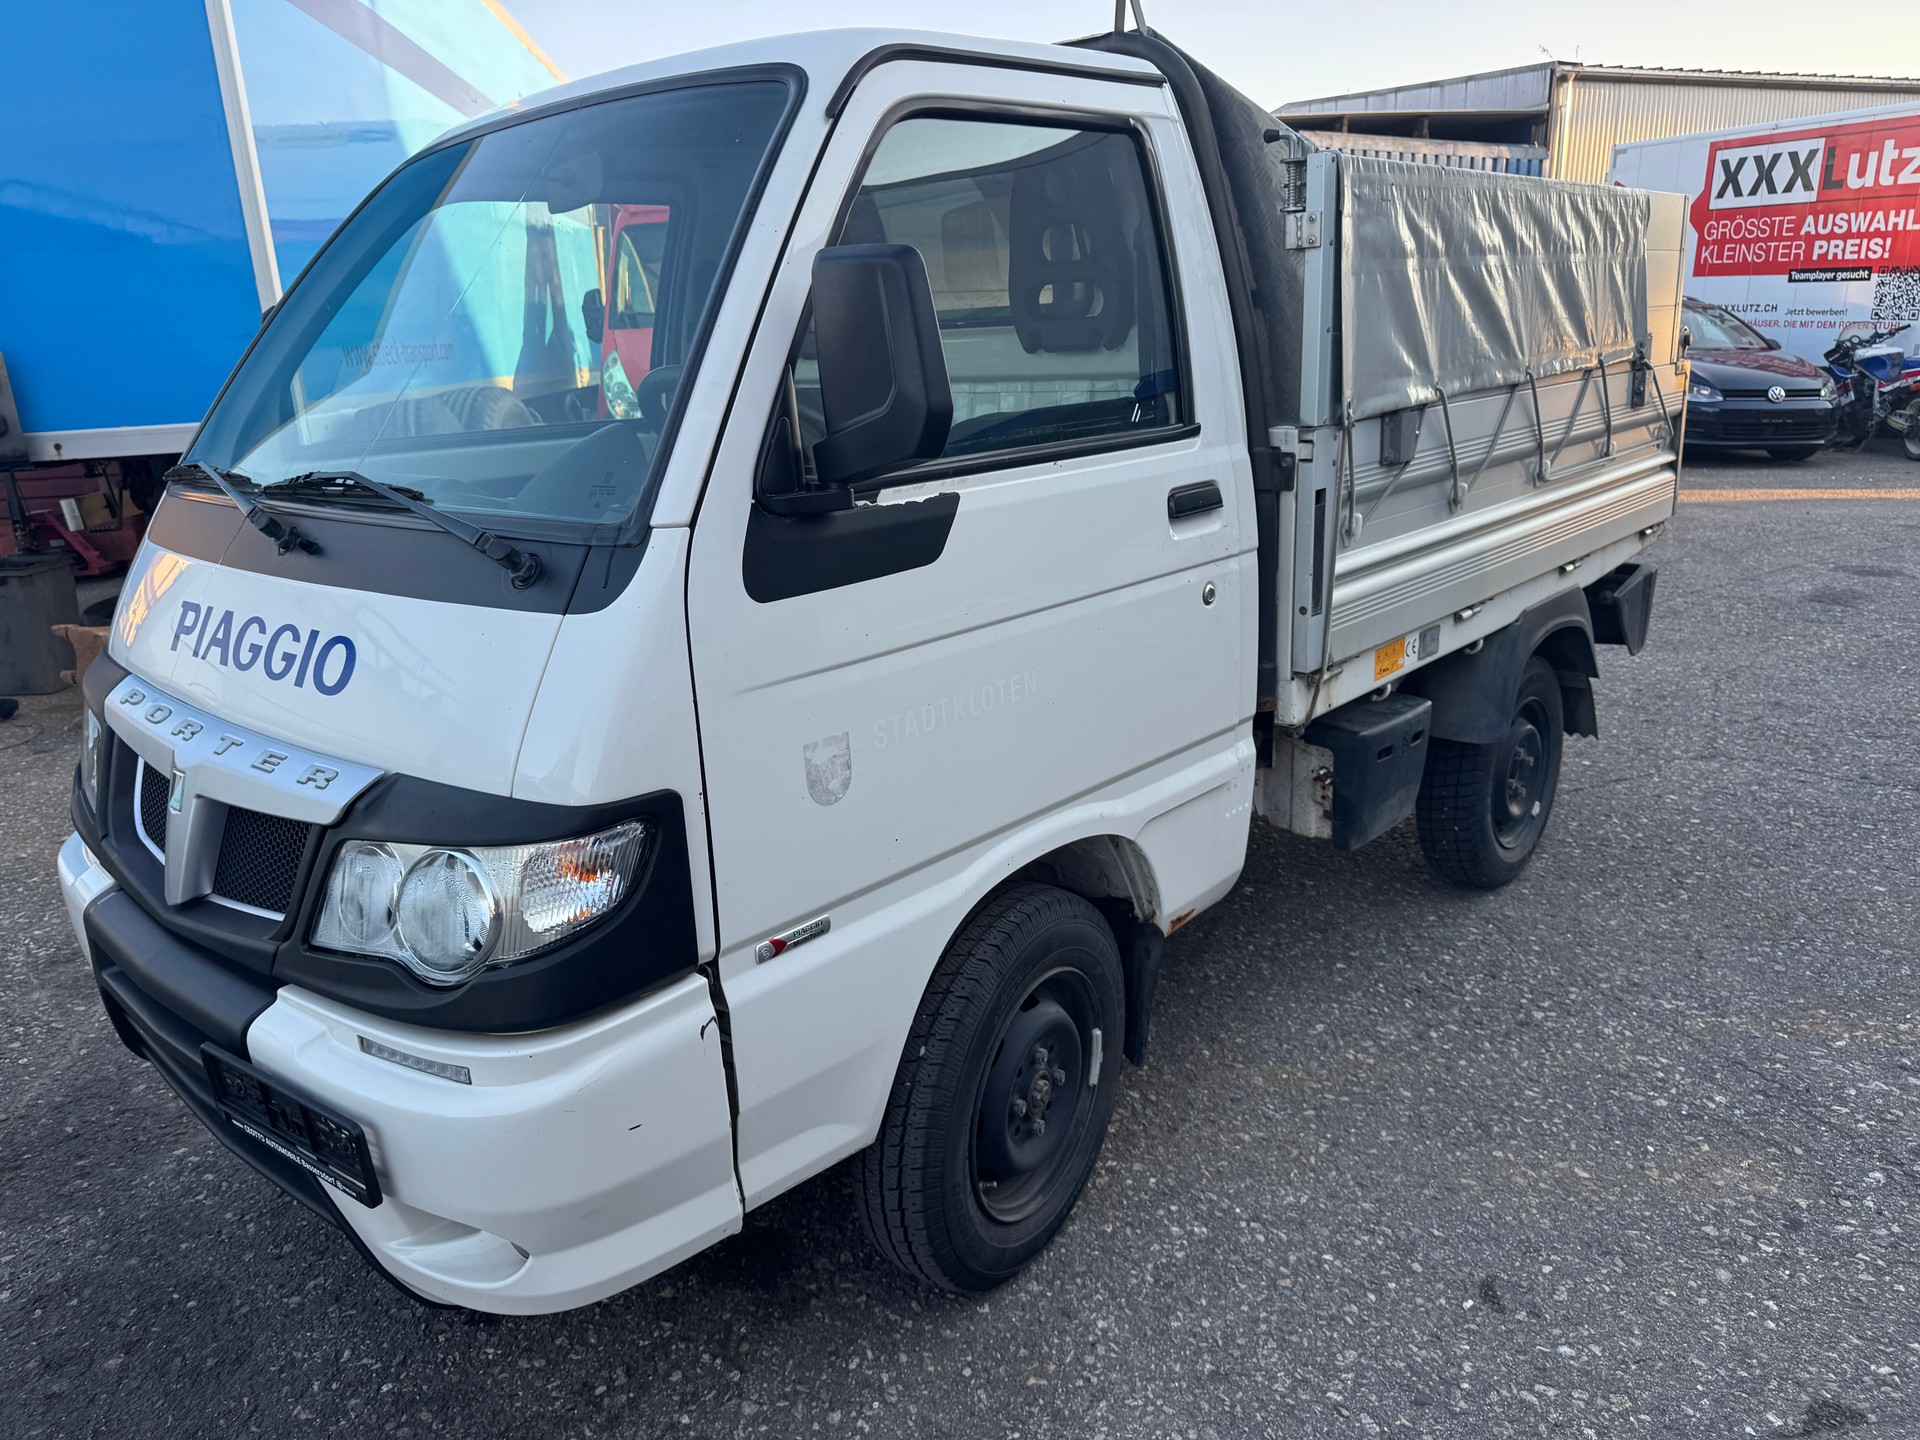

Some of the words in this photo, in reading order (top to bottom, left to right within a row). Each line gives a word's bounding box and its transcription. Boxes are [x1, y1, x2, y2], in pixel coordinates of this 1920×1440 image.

[1714, 139, 1920, 199] XXXLutz
[1704, 215, 1797, 240] GRÖSSTE
[1800, 208, 1920, 235] AUSWAHL
[1700, 241, 1805, 264] KLEINSTER
[1812, 237, 1892, 260] PREIS!
[1790, 270, 1835, 282] Teamplayer
[1836, 268, 1869, 281] gesucht
[1783, 320, 1797, 328] DIE
[1799, 320, 1814, 329] MIT
[1816, 321, 1836, 329] DEM
[1784, 308, 1804, 317] Jetzt
[1805, 308, 1848, 317] bewerben!
[170, 600, 357, 696] PIAGGIO
[119, 687, 339, 790] PORTER
[792, 919, 824, 938] PIAGGIO
